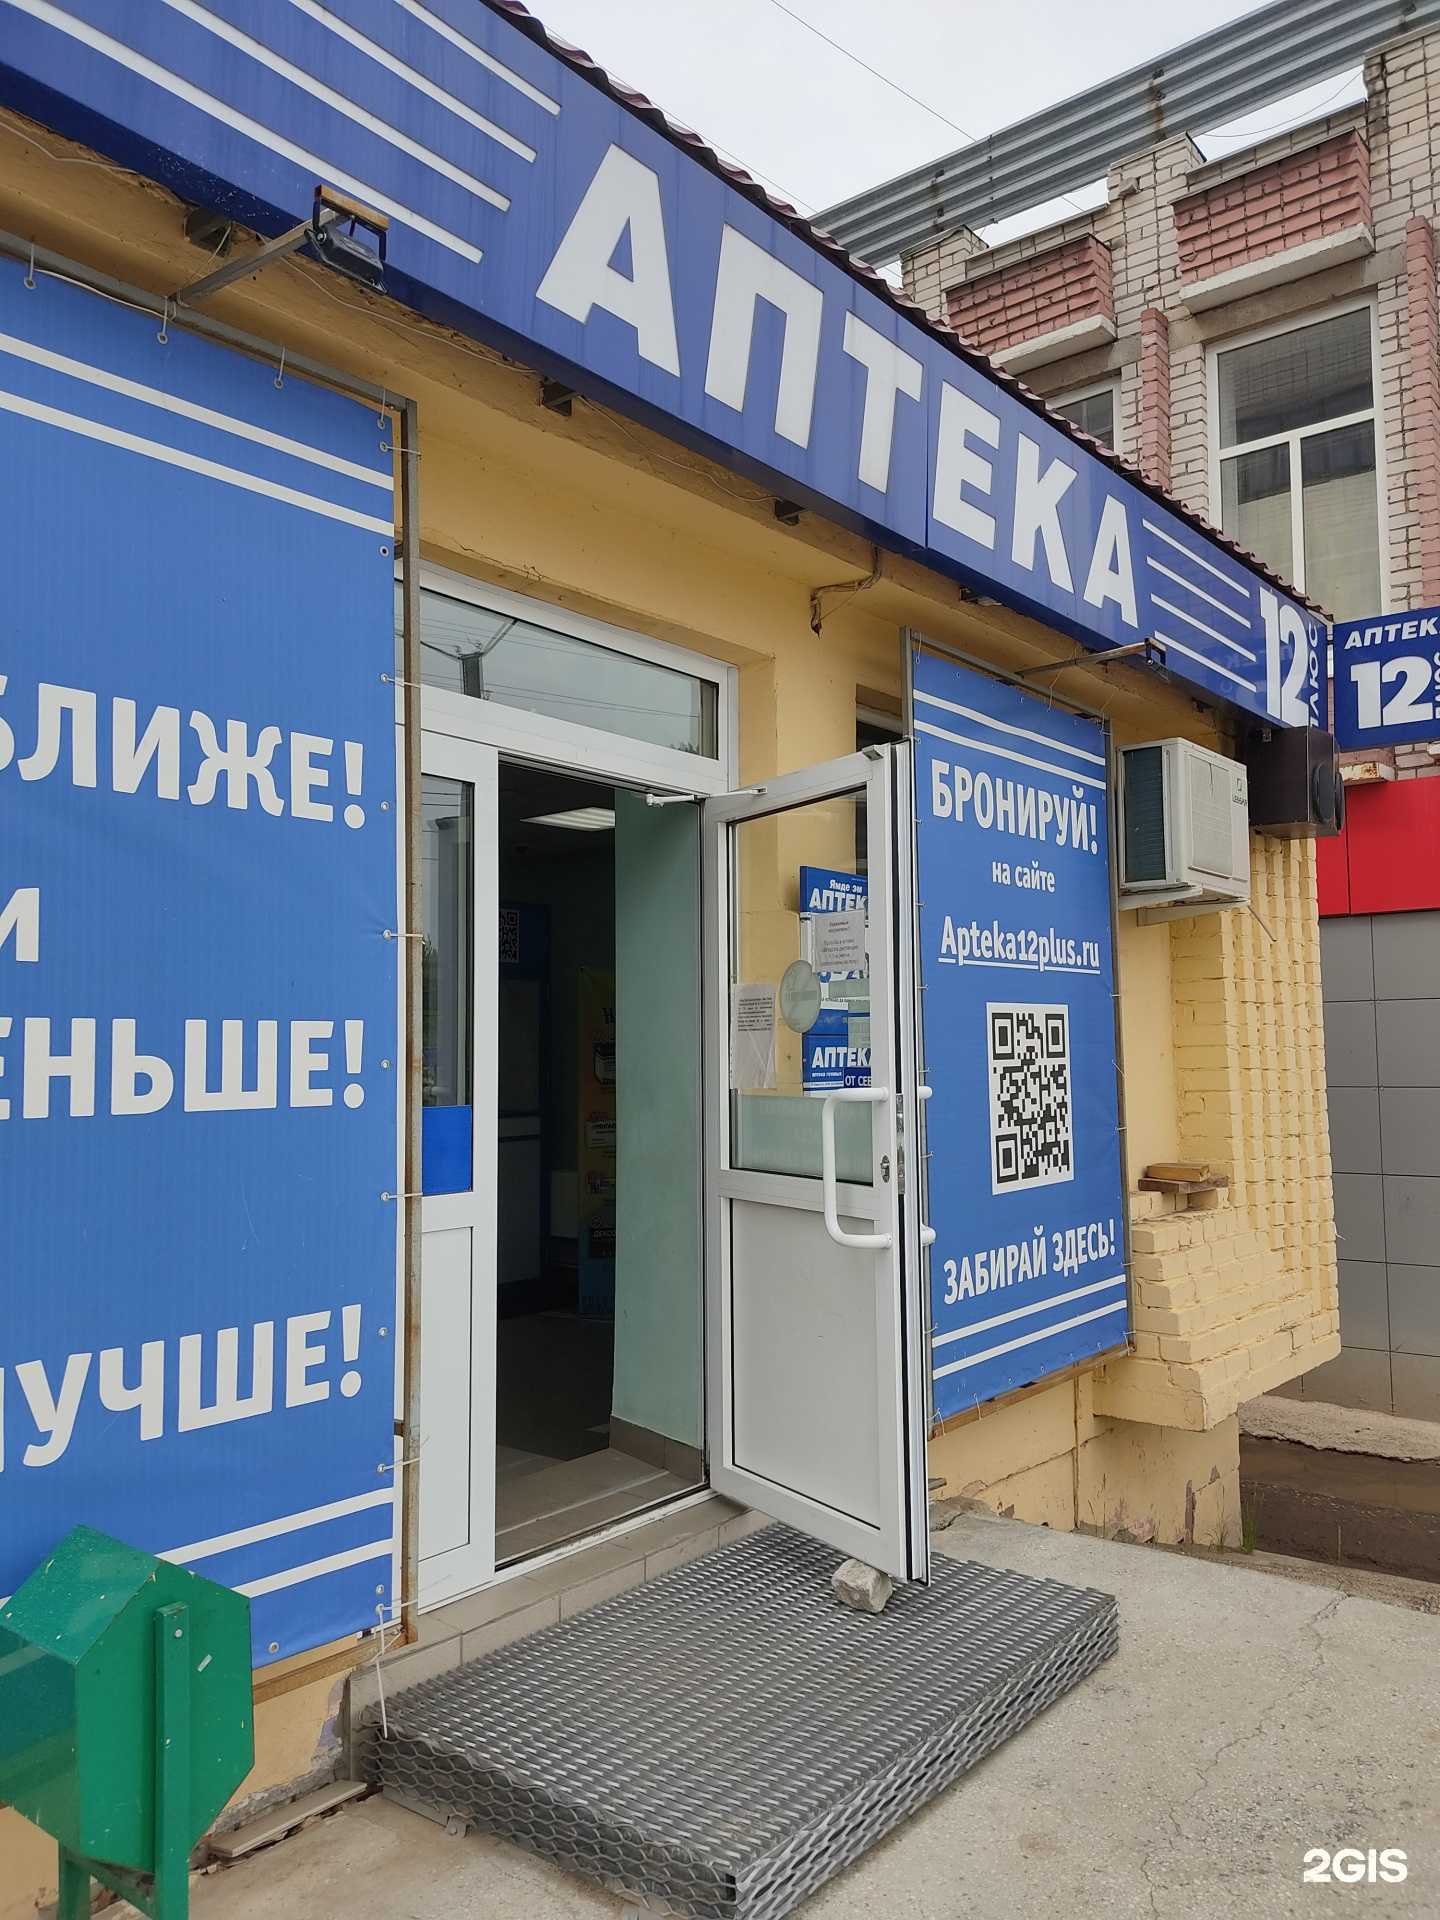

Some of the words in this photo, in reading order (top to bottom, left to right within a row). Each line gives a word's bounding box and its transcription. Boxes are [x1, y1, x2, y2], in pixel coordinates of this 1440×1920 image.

[535, 143, 1139, 629] АПТЕКА
[1259, 586, 1309, 728] 12
[1343, 616, 1440, 650] АПТЕК
[1350, 655, 1434, 730] 12
[931, 758, 1098, 855] БРОНИРУЙ!
[991, 861, 1010, 886] на
[1014, 860, 1056, 893] сайте
[940, 915, 1100, 972] Apteka12plus.ru
[0, 1016, 366, 1120] НЬШЕ!
[811, 1046, 871, 1069] АПТЕК
[845, 1075, 856, 1087] ОТ
[943, 1224, 1047, 1305] ЗАБИРАЙ
[1052, 1218, 1116, 1278] ЗДЕСЬ!
[0, 1303, 363, 1473] УЧШЕ!
